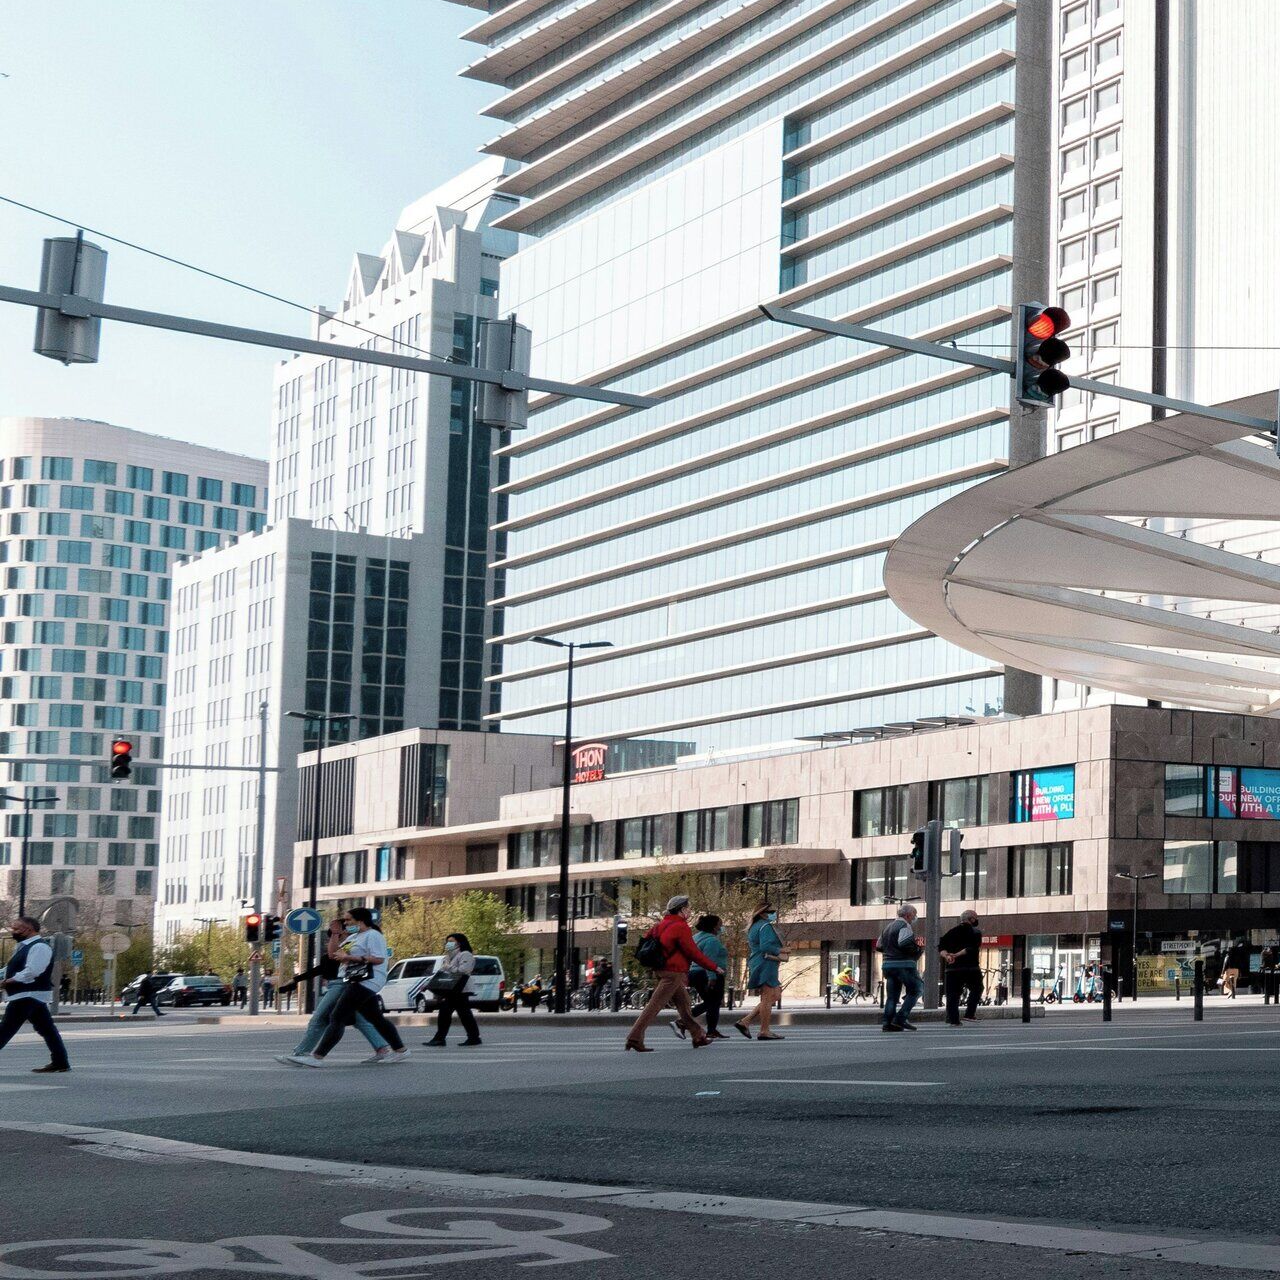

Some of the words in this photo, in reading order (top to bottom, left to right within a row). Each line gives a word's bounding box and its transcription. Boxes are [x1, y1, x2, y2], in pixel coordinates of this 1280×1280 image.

[572, 743, 608, 768] THON
[575, 770, 604, 783] HOTELS
[1035, 785, 1064, 794] BUILDING
[1241, 795, 1262, 803] NEW
[1265, 804, 1274, 813] A
[1150, 970, 1162, 978] ARE
